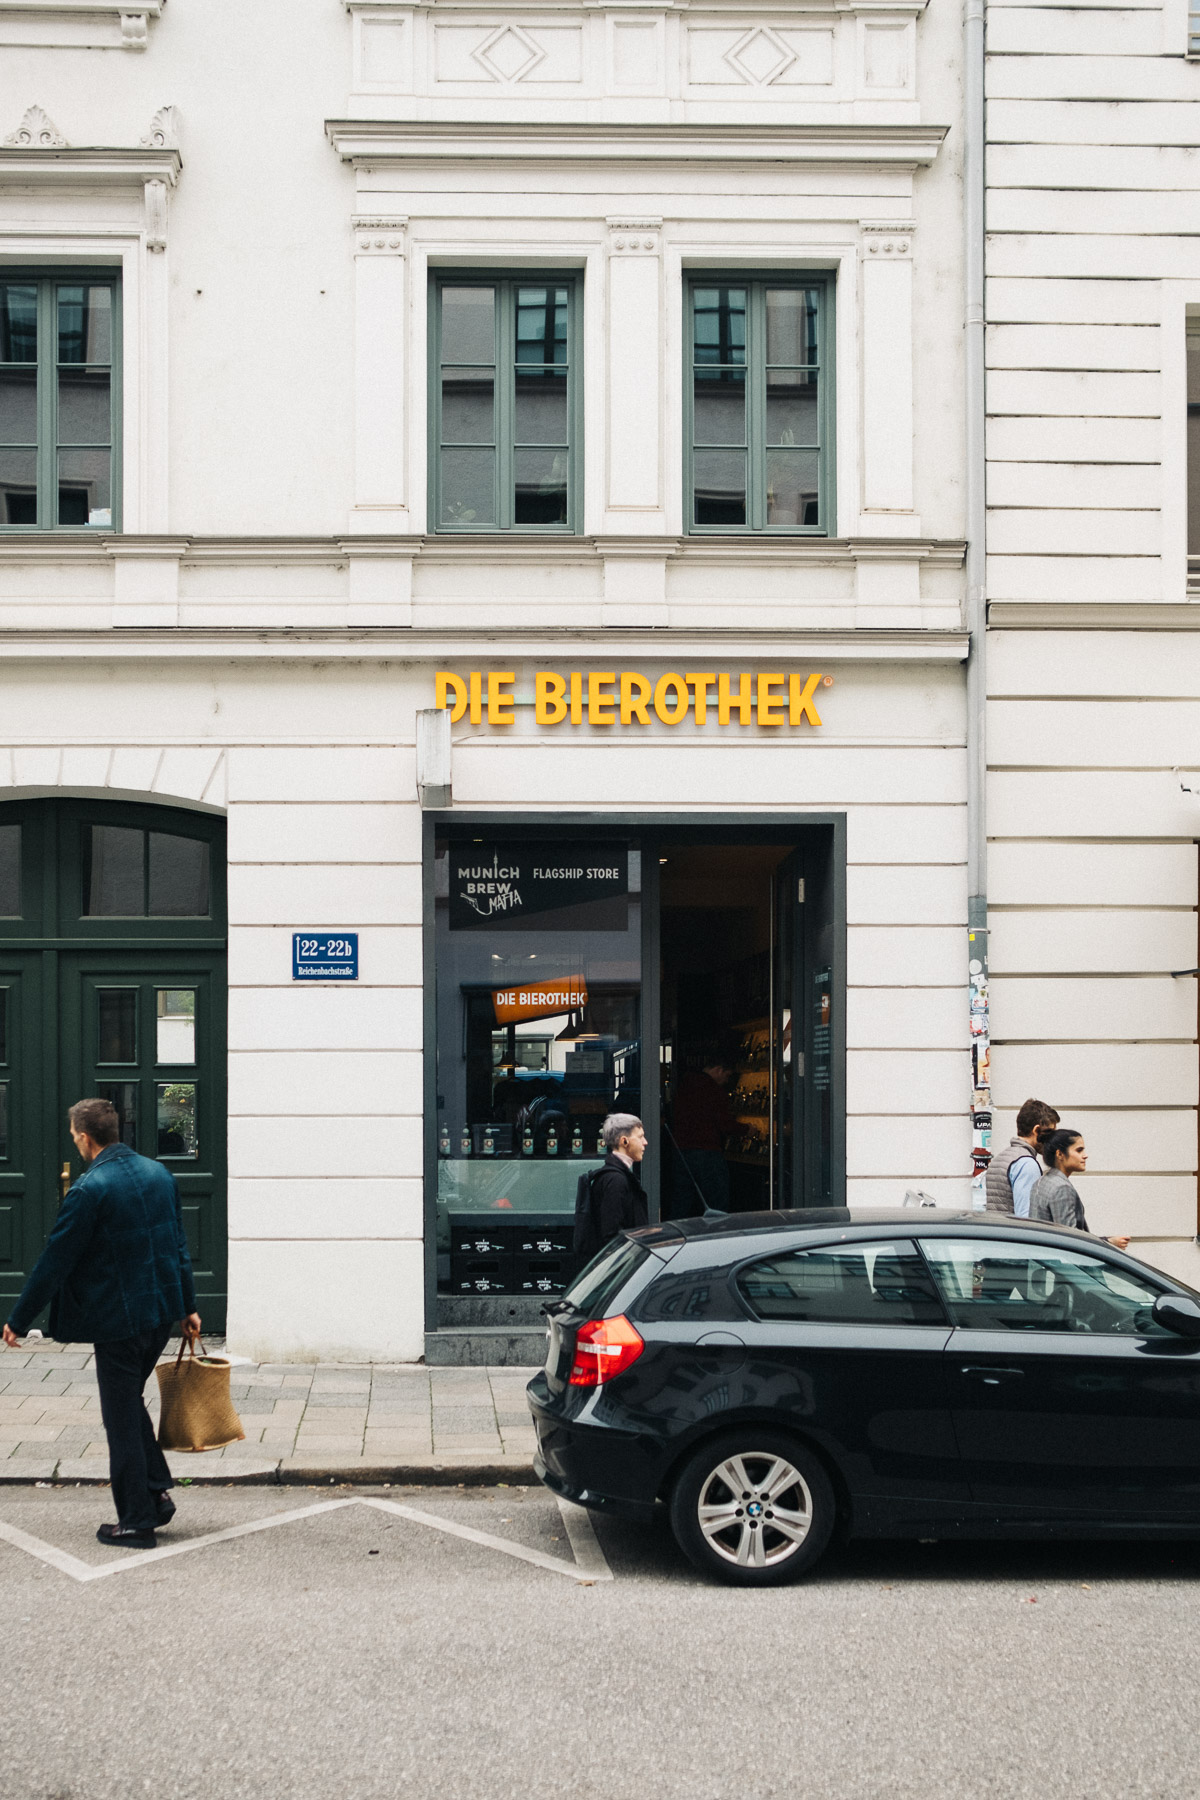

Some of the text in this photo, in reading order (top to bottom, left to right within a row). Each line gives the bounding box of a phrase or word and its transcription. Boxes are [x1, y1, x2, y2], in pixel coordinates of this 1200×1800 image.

[435, 671, 515, 725] DIE
[458, 863, 520, 879] MUNICH
[533, 868, 619, 879] FLAGSHIP STORE
[467, 883, 511, 894] BREW
[489, 889, 523, 913] MAFIA
[301, 940, 352, 956] 22-22b
[496, 992, 585, 1005] DIE BIEROTHEK
